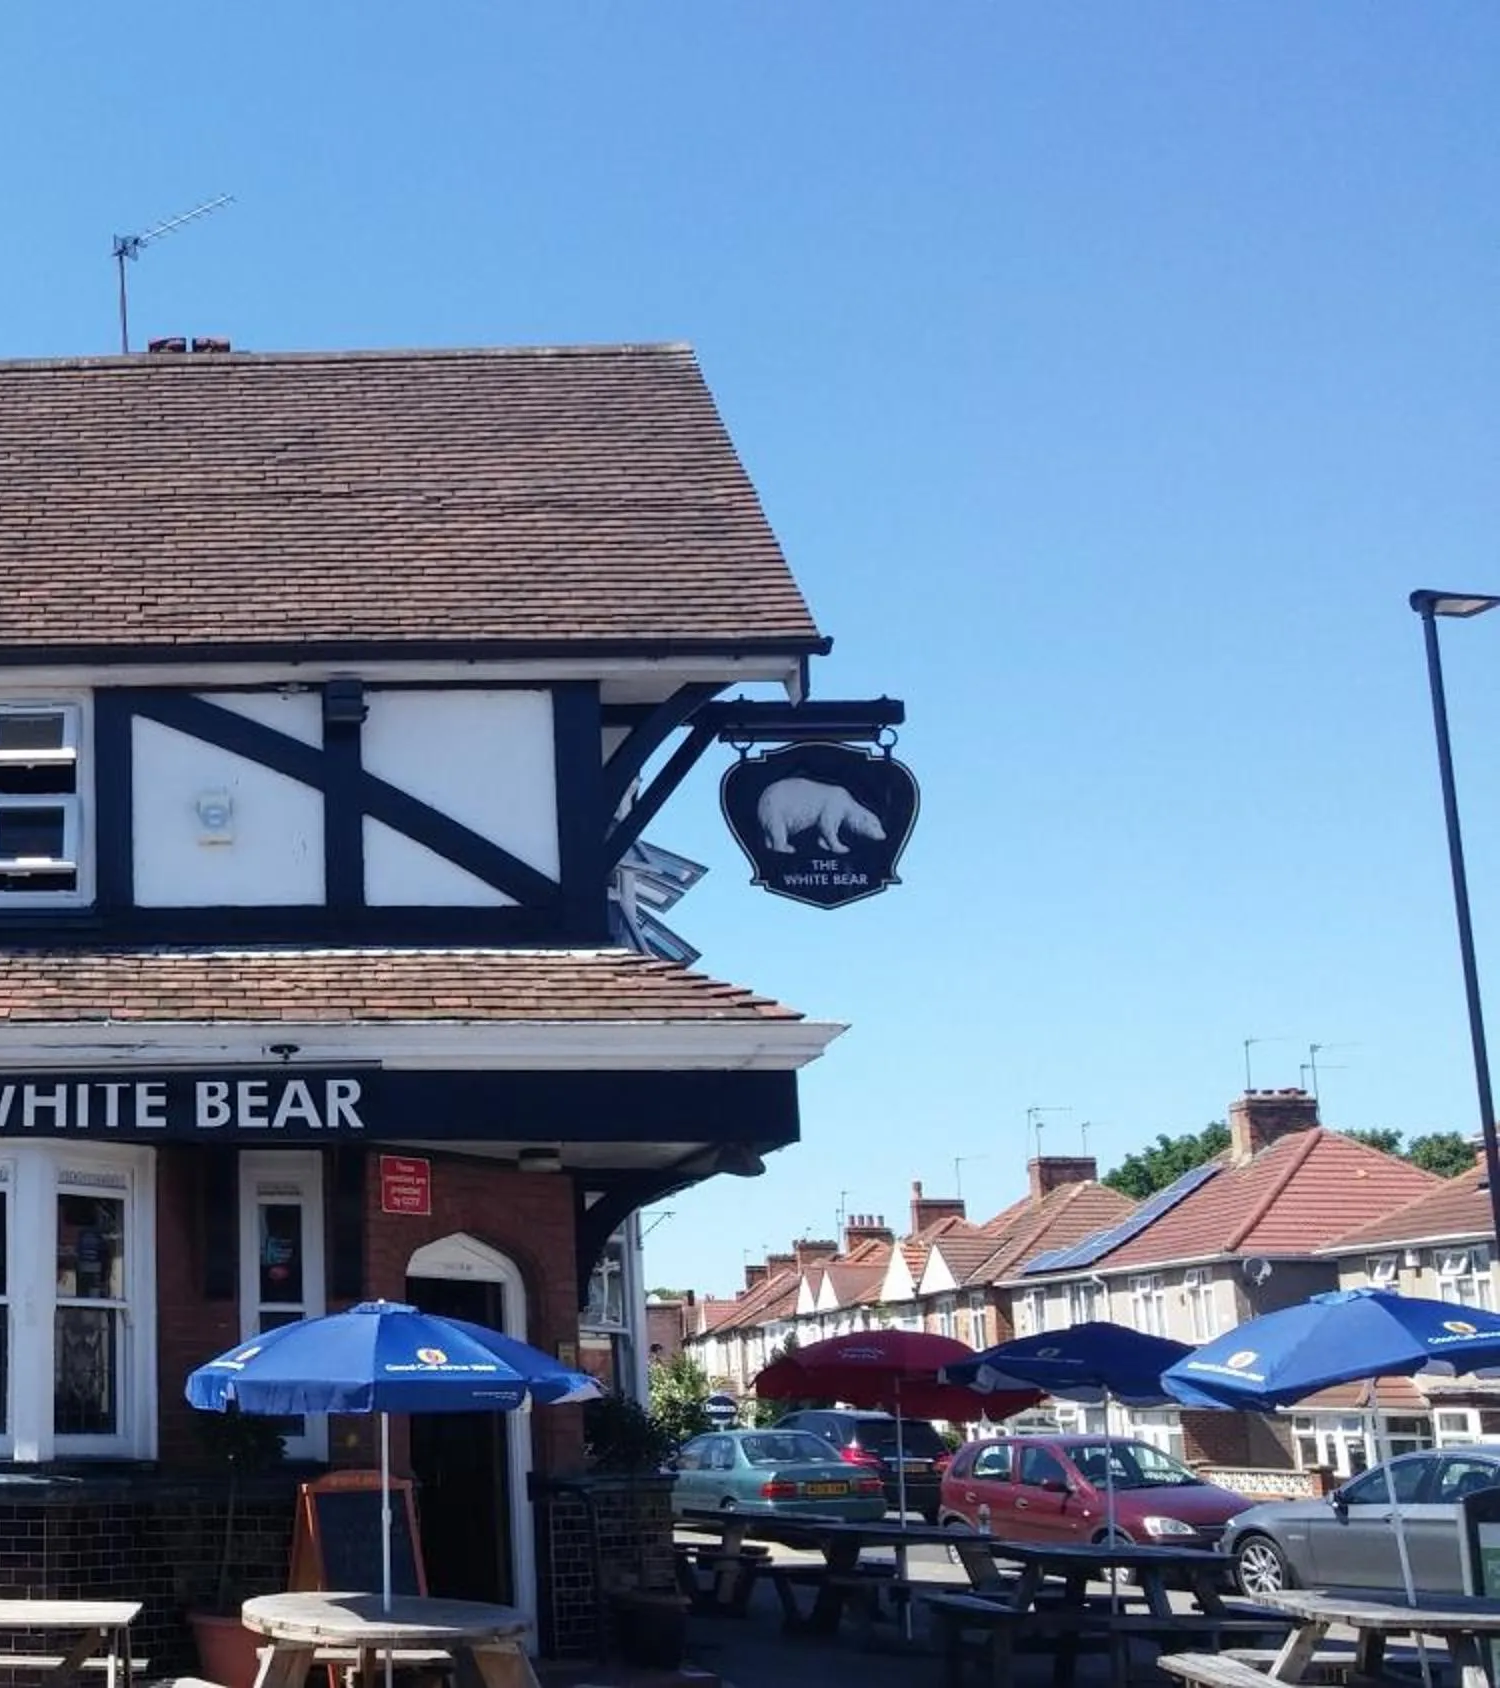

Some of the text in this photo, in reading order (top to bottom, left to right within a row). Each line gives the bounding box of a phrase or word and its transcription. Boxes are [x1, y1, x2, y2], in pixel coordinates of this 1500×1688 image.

[812, 860, 838, 870] THE
[784, 874, 868, 885] WHITE BEAR
[195, 1080, 364, 1127] BEAR
